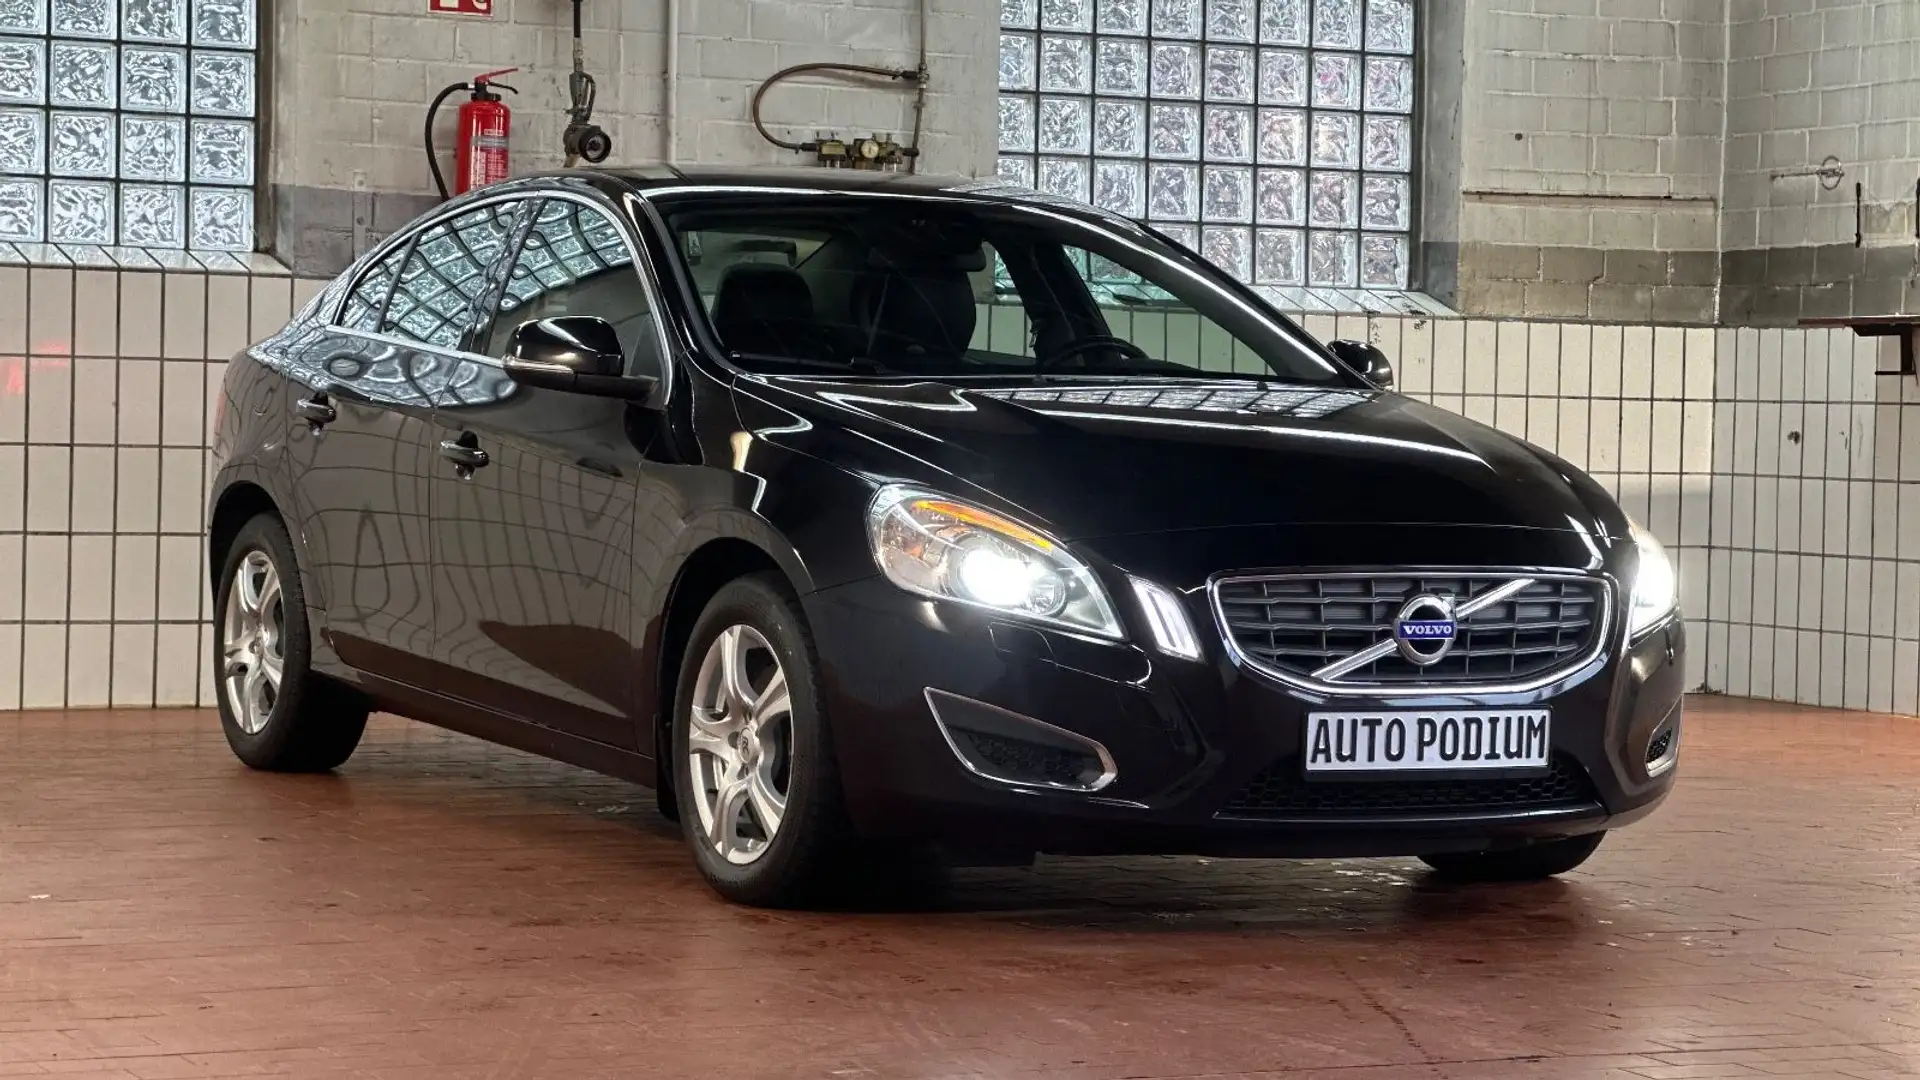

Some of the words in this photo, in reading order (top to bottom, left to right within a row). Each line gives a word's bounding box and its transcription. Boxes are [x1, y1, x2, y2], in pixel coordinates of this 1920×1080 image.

[1403, 625, 1452, 635] VOLVO
[1310, 717, 1406, 763] AUTO
[1416, 715, 1547, 762] PODIUM
